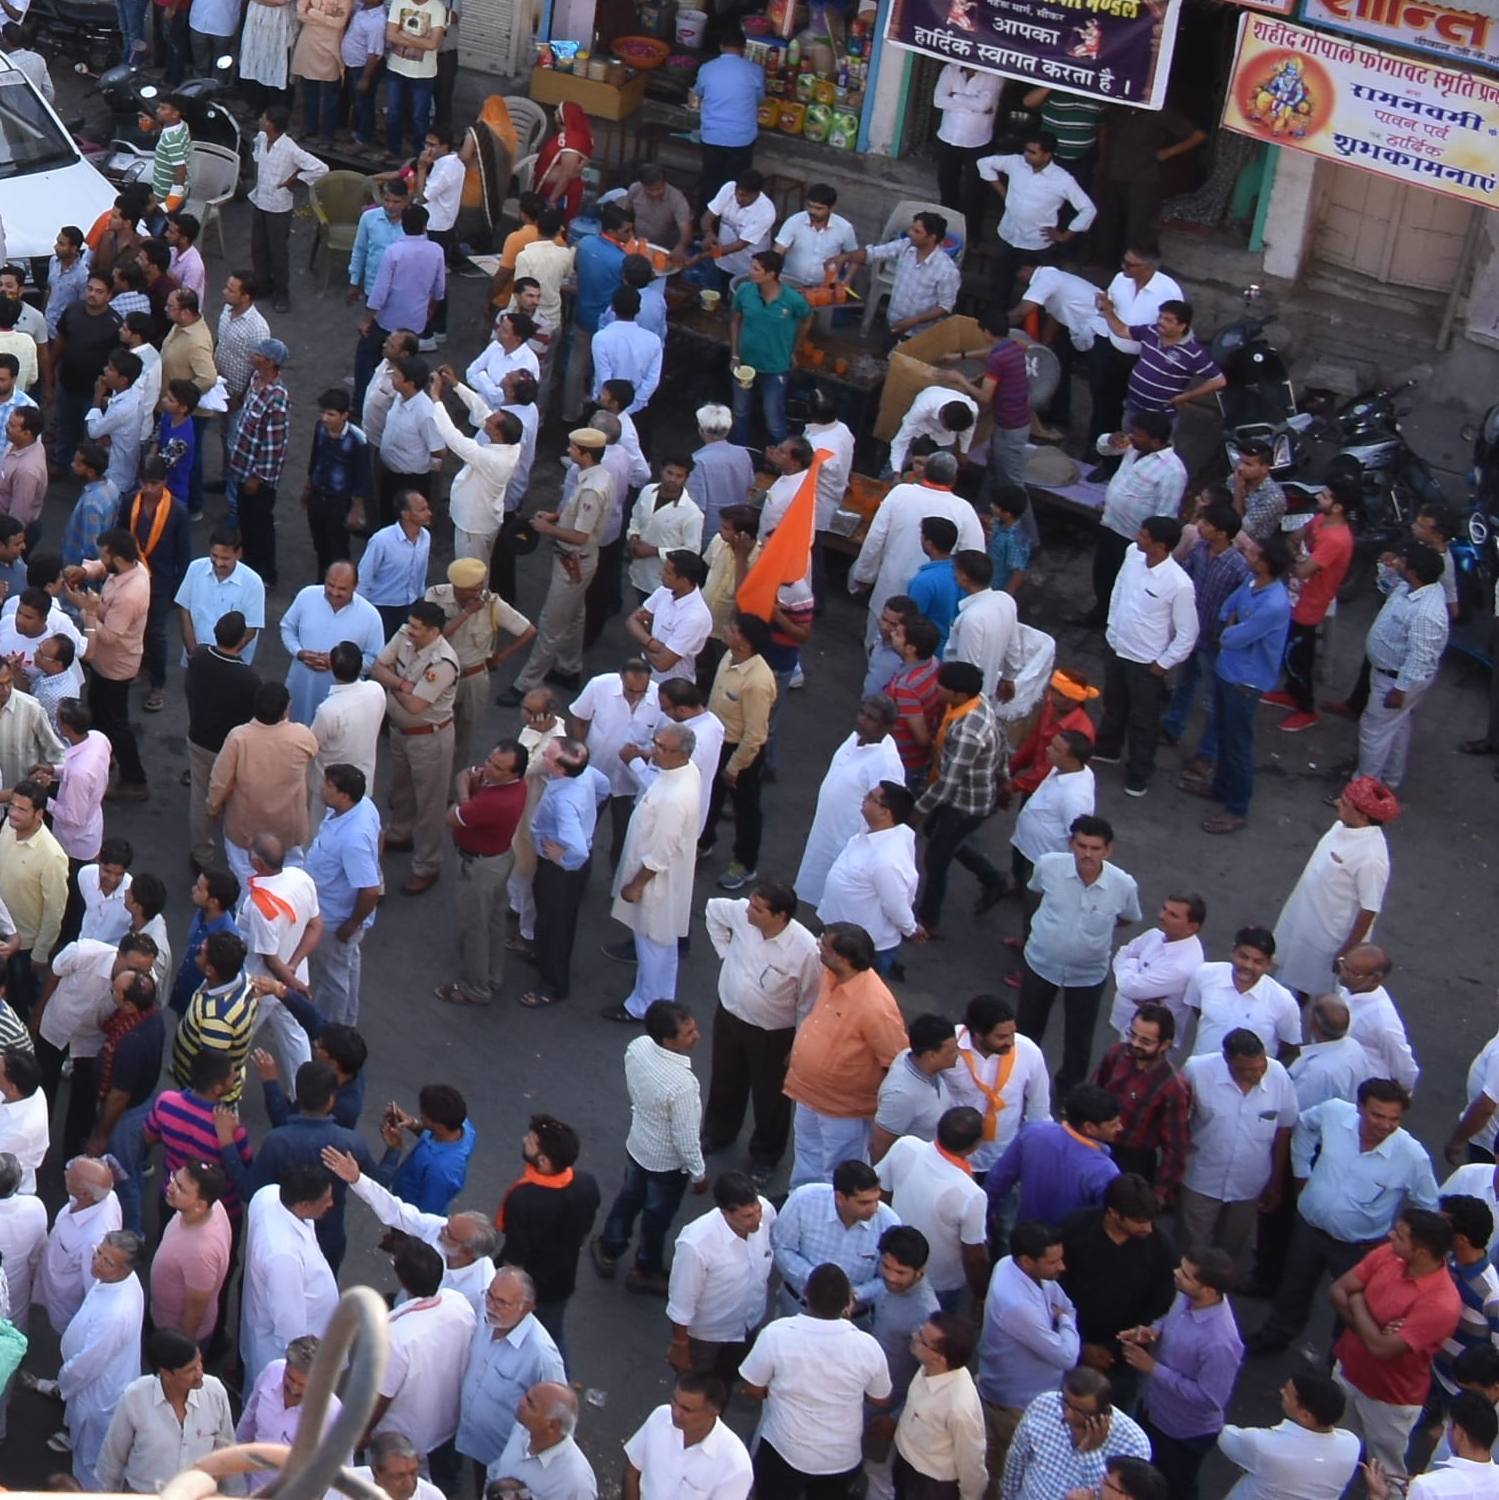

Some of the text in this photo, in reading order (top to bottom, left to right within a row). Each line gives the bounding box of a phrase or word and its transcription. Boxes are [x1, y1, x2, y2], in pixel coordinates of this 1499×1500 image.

[992, 15, 1061, 47] आपका
[1036, 7, 1066, 22] सीकर
[913, 25, 973, 59] हार्दिक
[976, 40, 1037, 73] स्वागत
[1040, 57, 1095, 89] करता
[1098, 69, 1114, 93] है
[1253, 20, 1297, 49] शहीद
[1300, 31, 1354, 64] गोपाल
[1358, 51, 1428, 85] फोगावट
[1433, 68, 1475, 99] स्मृति
[1350, 81, 1485, 132] रामनवमी
[1374, 108, 1452, 141] पावन पर्व
[1332, 131, 1497, 193] शुभकामनाएं
[1385, 132, 1444, 158] हार्दिक
